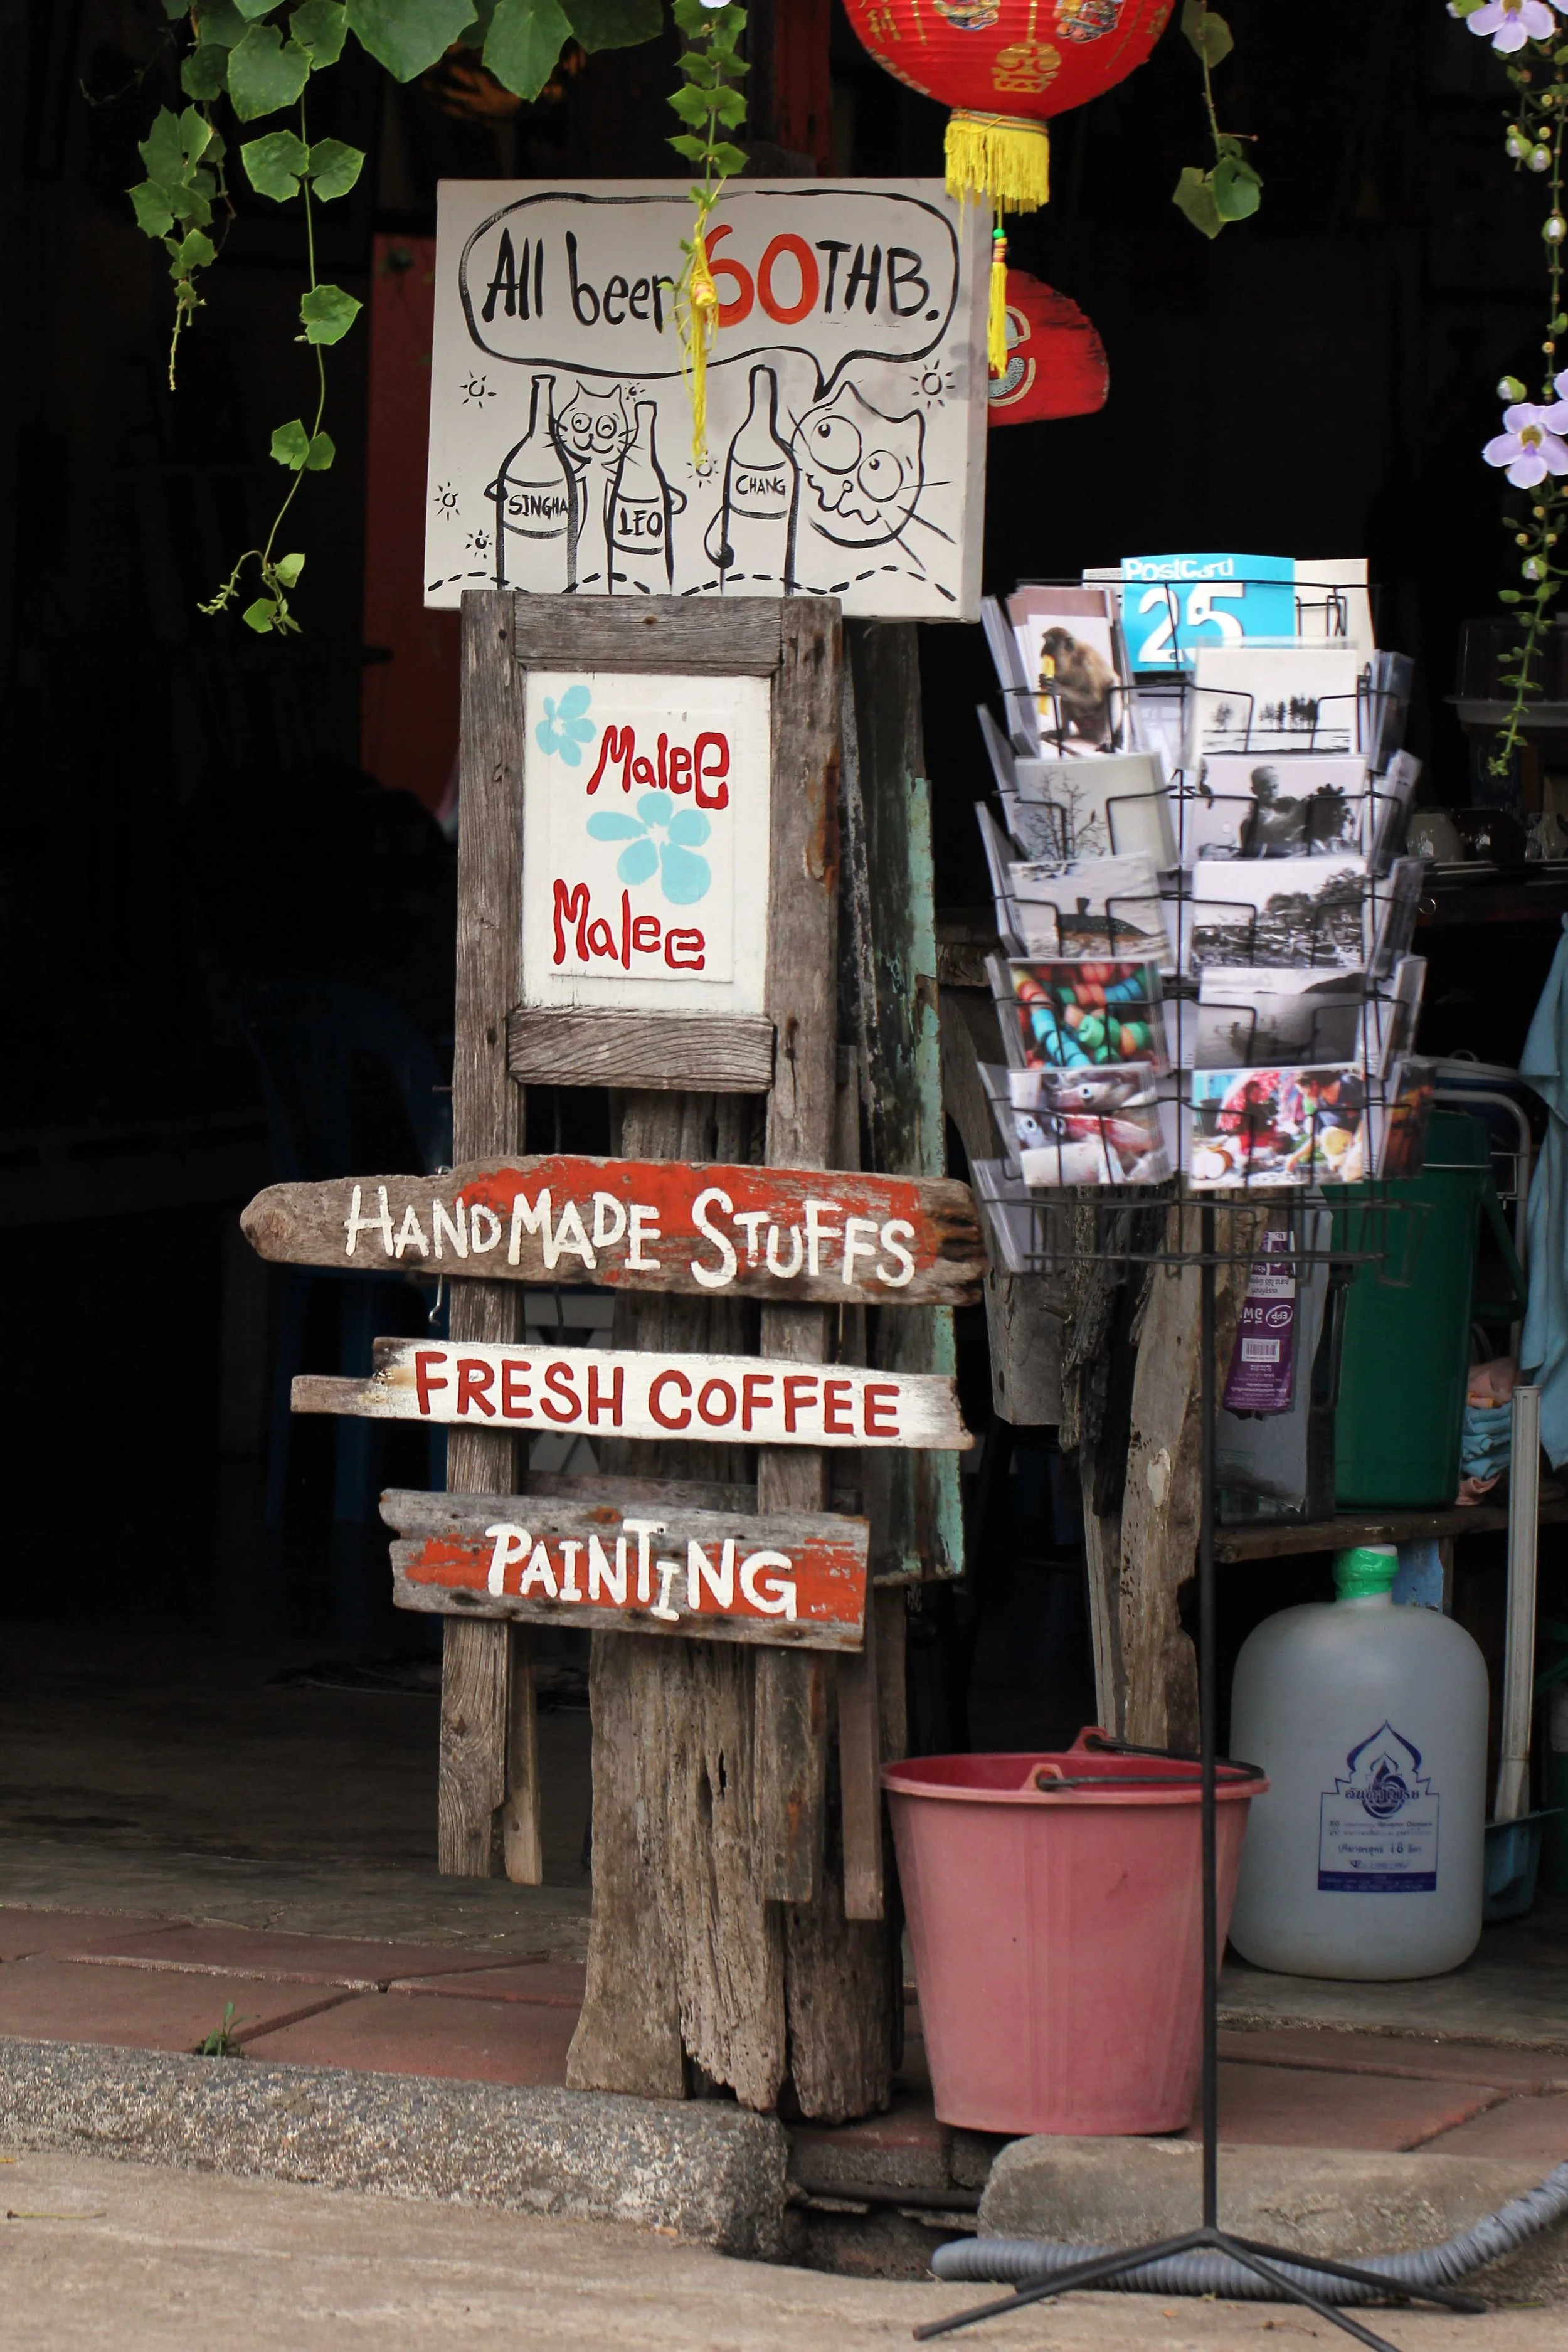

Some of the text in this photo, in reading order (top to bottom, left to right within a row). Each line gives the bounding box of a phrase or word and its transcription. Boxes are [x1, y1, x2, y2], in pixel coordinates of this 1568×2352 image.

[482, 228, 544, 324] All
[566, 231, 674, 334] beer
[508, 492, 569, 518] SINGHA
[617, 507, 664, 538] LEO
[735, 474, 787, 497] CHANG
[1138, 582, 1245, 663] 25
[586, 725, 730, 810] Malee
[553, 879, 706, 971] Malee
[691, 1186, 916, 1289] STUFFS
[415, 1351, 900, 1438] FRESH COFFEE
[1391, 1842, 1404, 1853] 18
